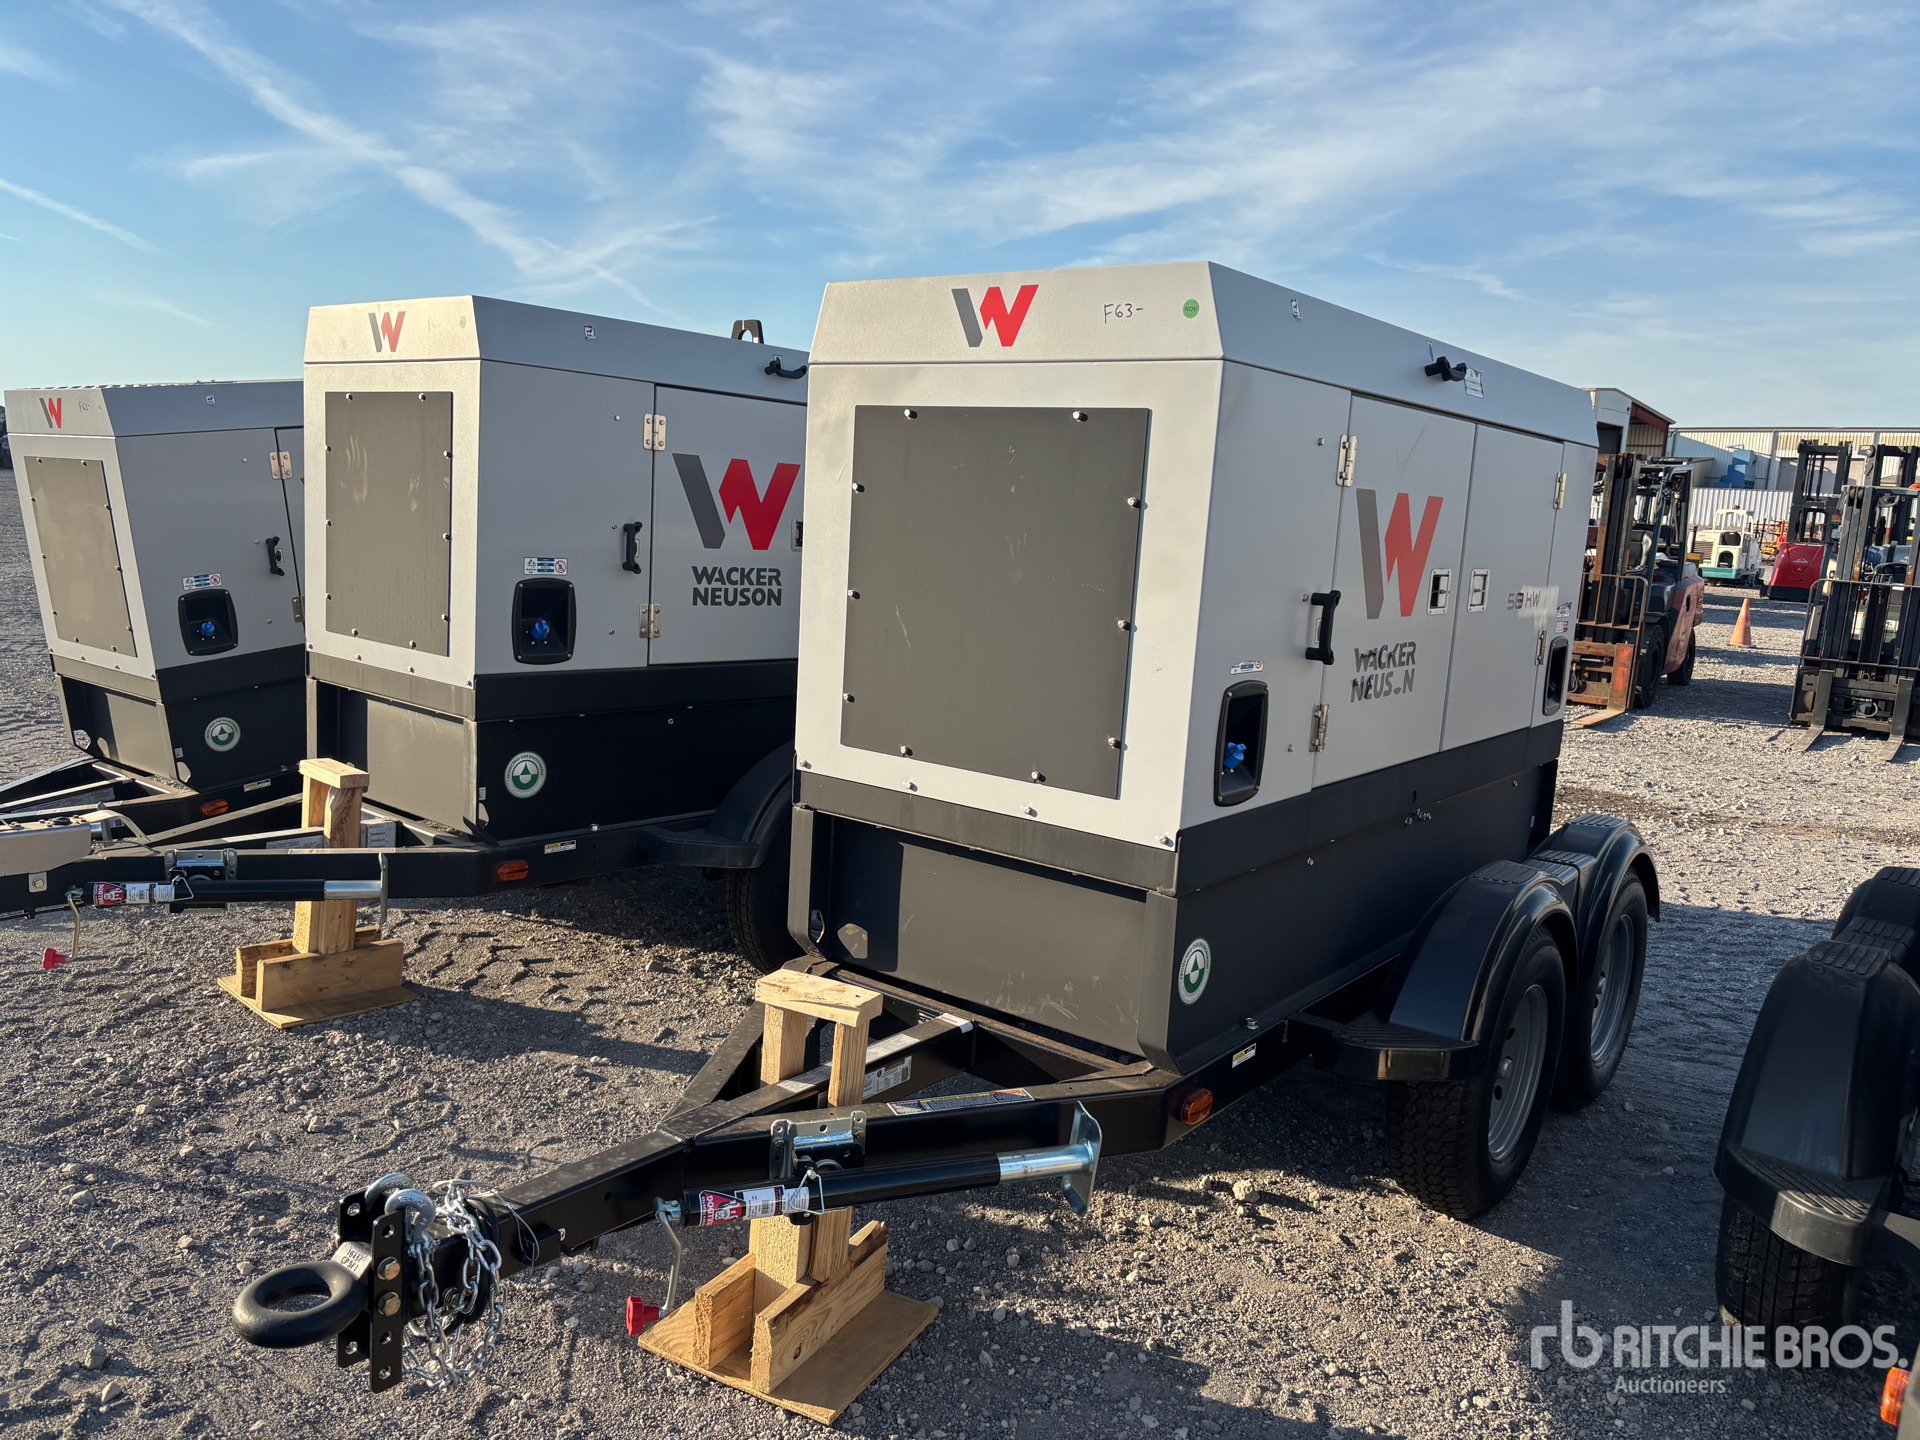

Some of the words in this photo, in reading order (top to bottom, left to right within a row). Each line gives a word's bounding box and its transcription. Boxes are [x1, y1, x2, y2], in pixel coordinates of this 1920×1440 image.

[692, 566, 782, 587] WACKER
[692, 587, 782, 606] NEUSON
[1354, 641, 1416, 672] WACKER
